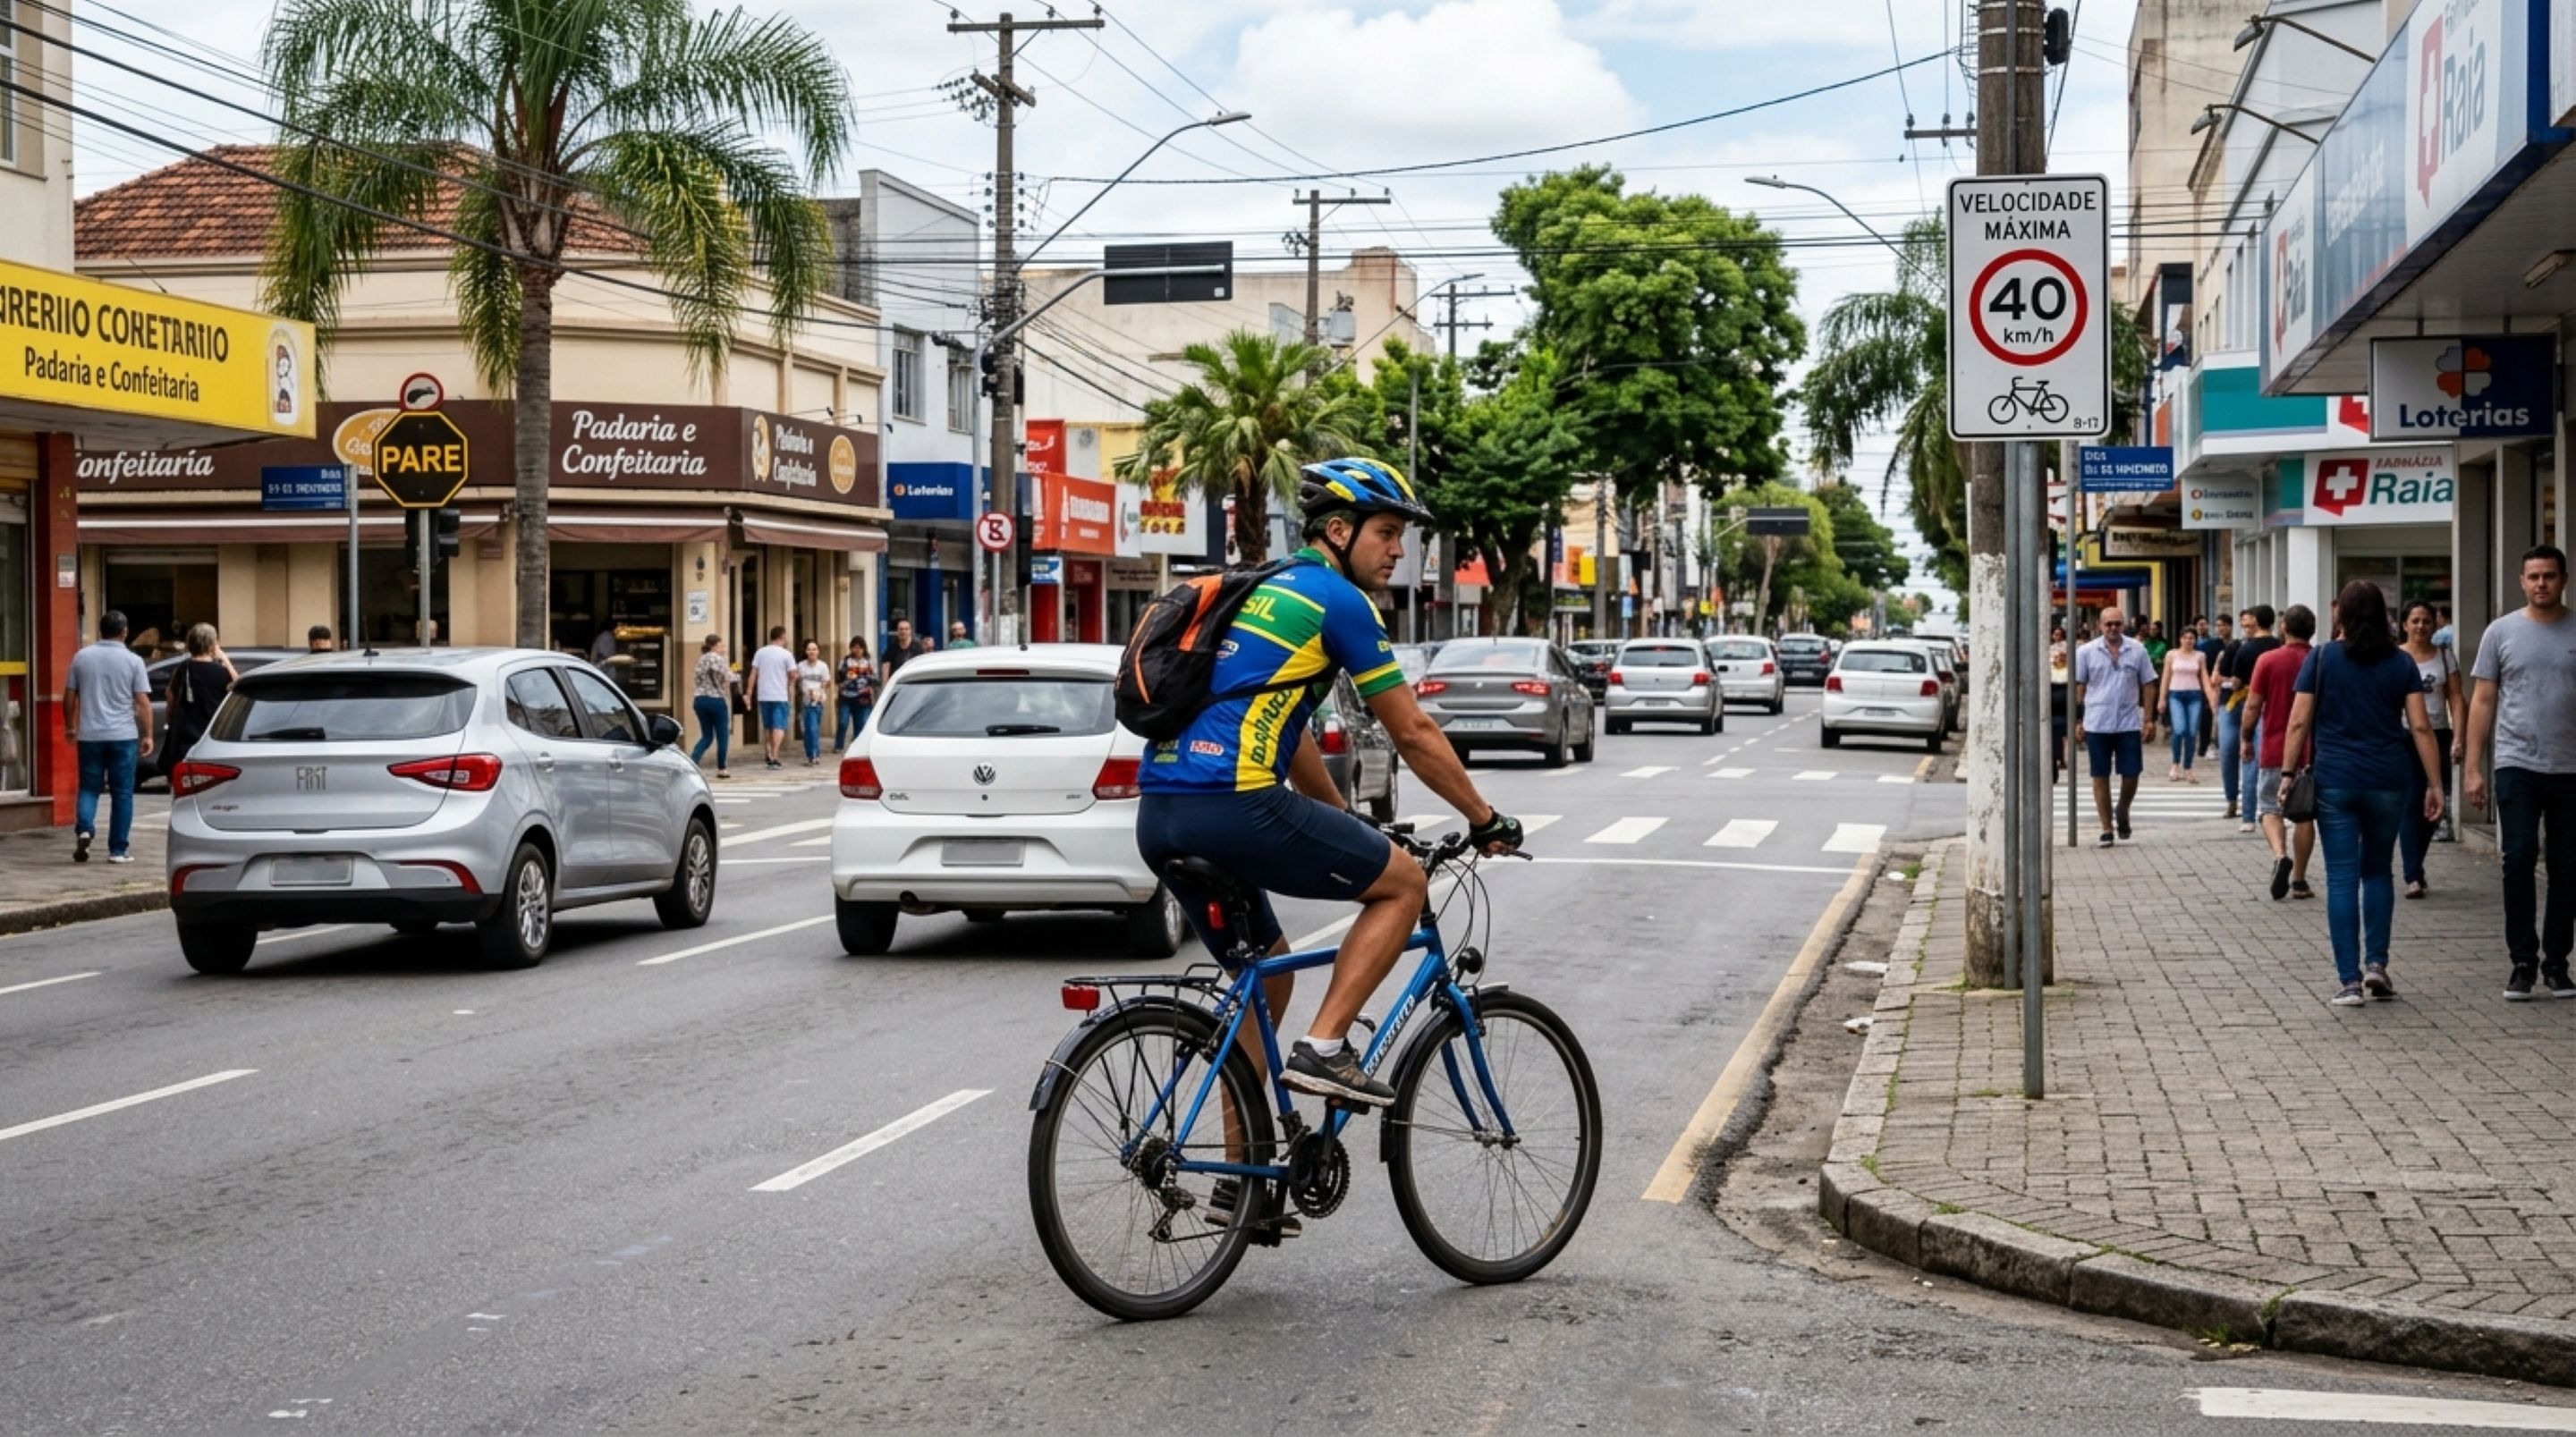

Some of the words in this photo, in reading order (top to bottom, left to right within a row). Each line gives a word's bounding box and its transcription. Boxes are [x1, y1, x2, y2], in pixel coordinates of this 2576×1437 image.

[1960, 191, 2097, 213] VELOCIDADE
[1985, 216, 2072, 241] MÁXIMA
[1988, 276, 2066, 321] 40
[2004, 327, 2054, 344] km/h
[25, 345, 91, 385] Padaria
[97, 366, 106, 388] e
[111, 360, 199, 402] Confeitaria
[572, 410, 677, 442] Padaria
[682, 423, 697, 442] e
[2400, 402, 2529, 428] Loterias
[382, 445, 462, 473] PARE
[562, 444, 707, 480] Confeitaria
[2369, 470, 2453, 504] Raia
